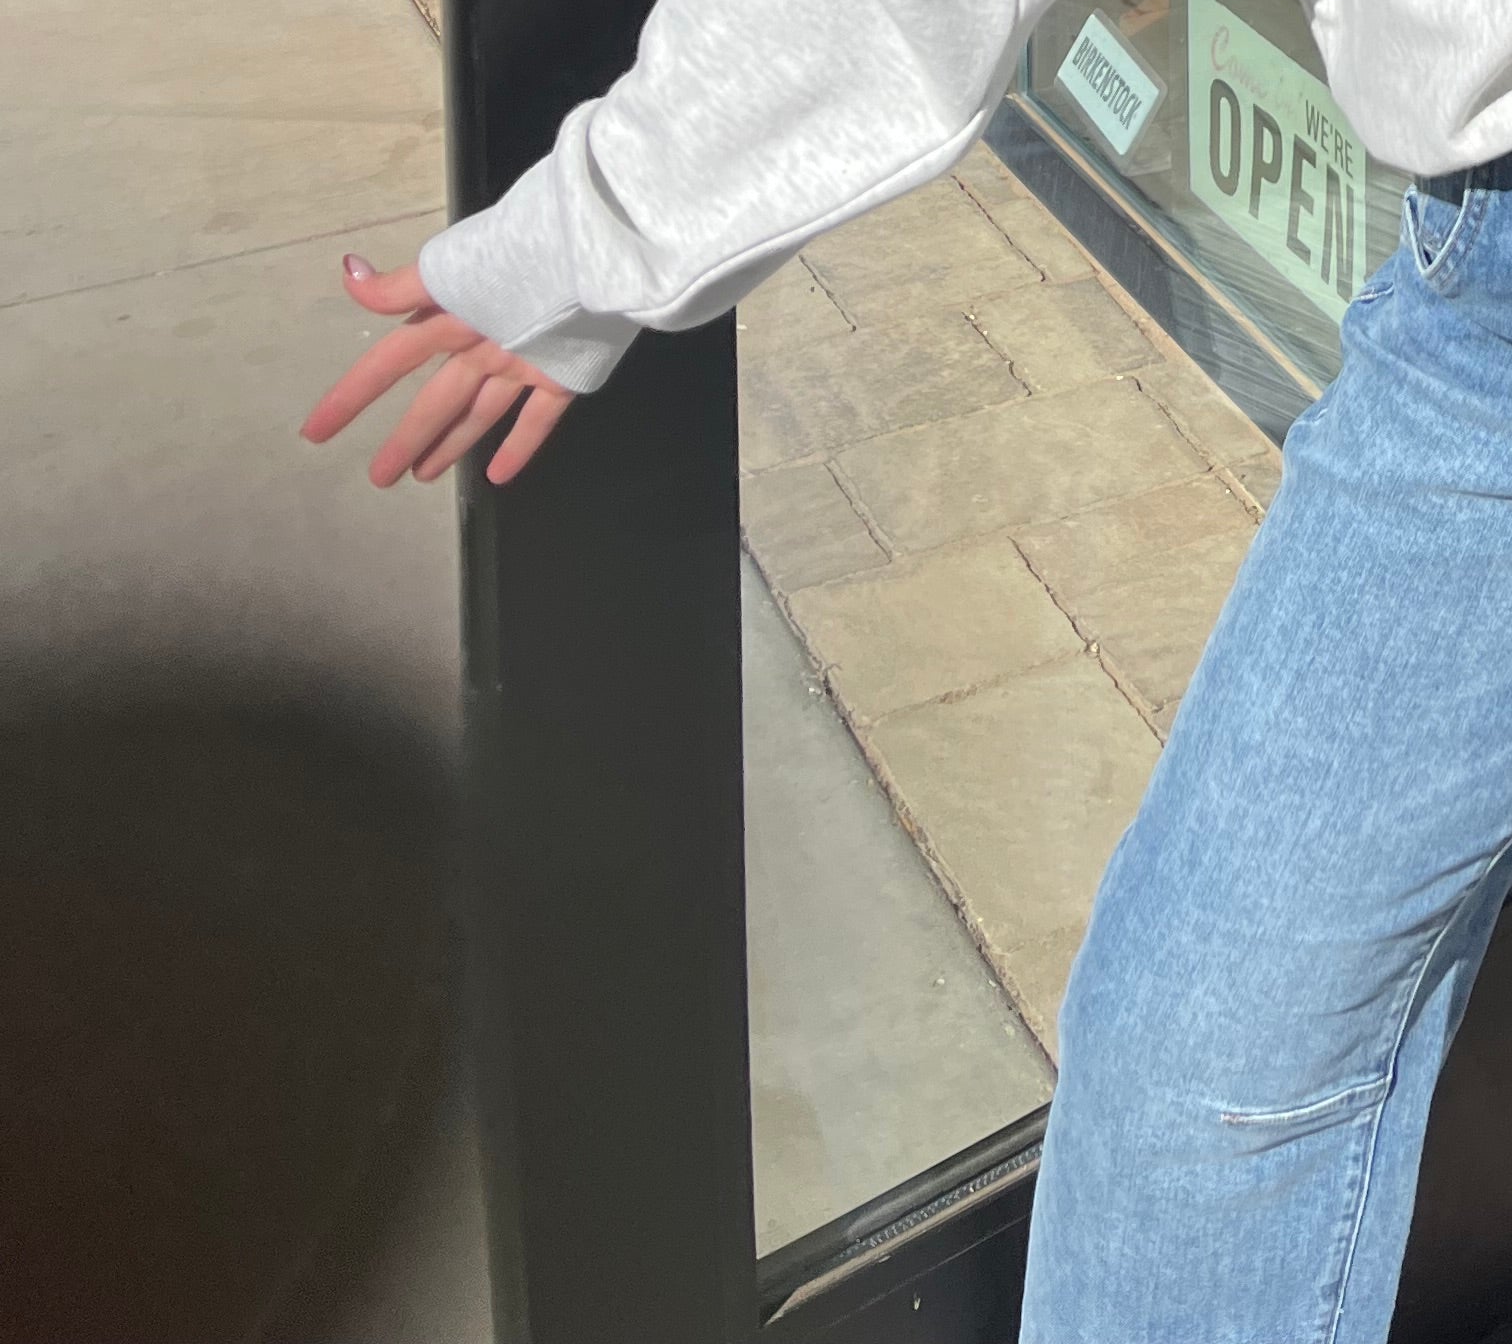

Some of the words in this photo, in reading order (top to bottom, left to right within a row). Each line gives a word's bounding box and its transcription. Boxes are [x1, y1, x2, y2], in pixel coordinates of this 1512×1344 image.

[1072, 36, 1142, 131] BIRKENSTOCK
[1305, 99, 1355, 180] WE'RE
[1209, 78, 1355, 305] OPEN
